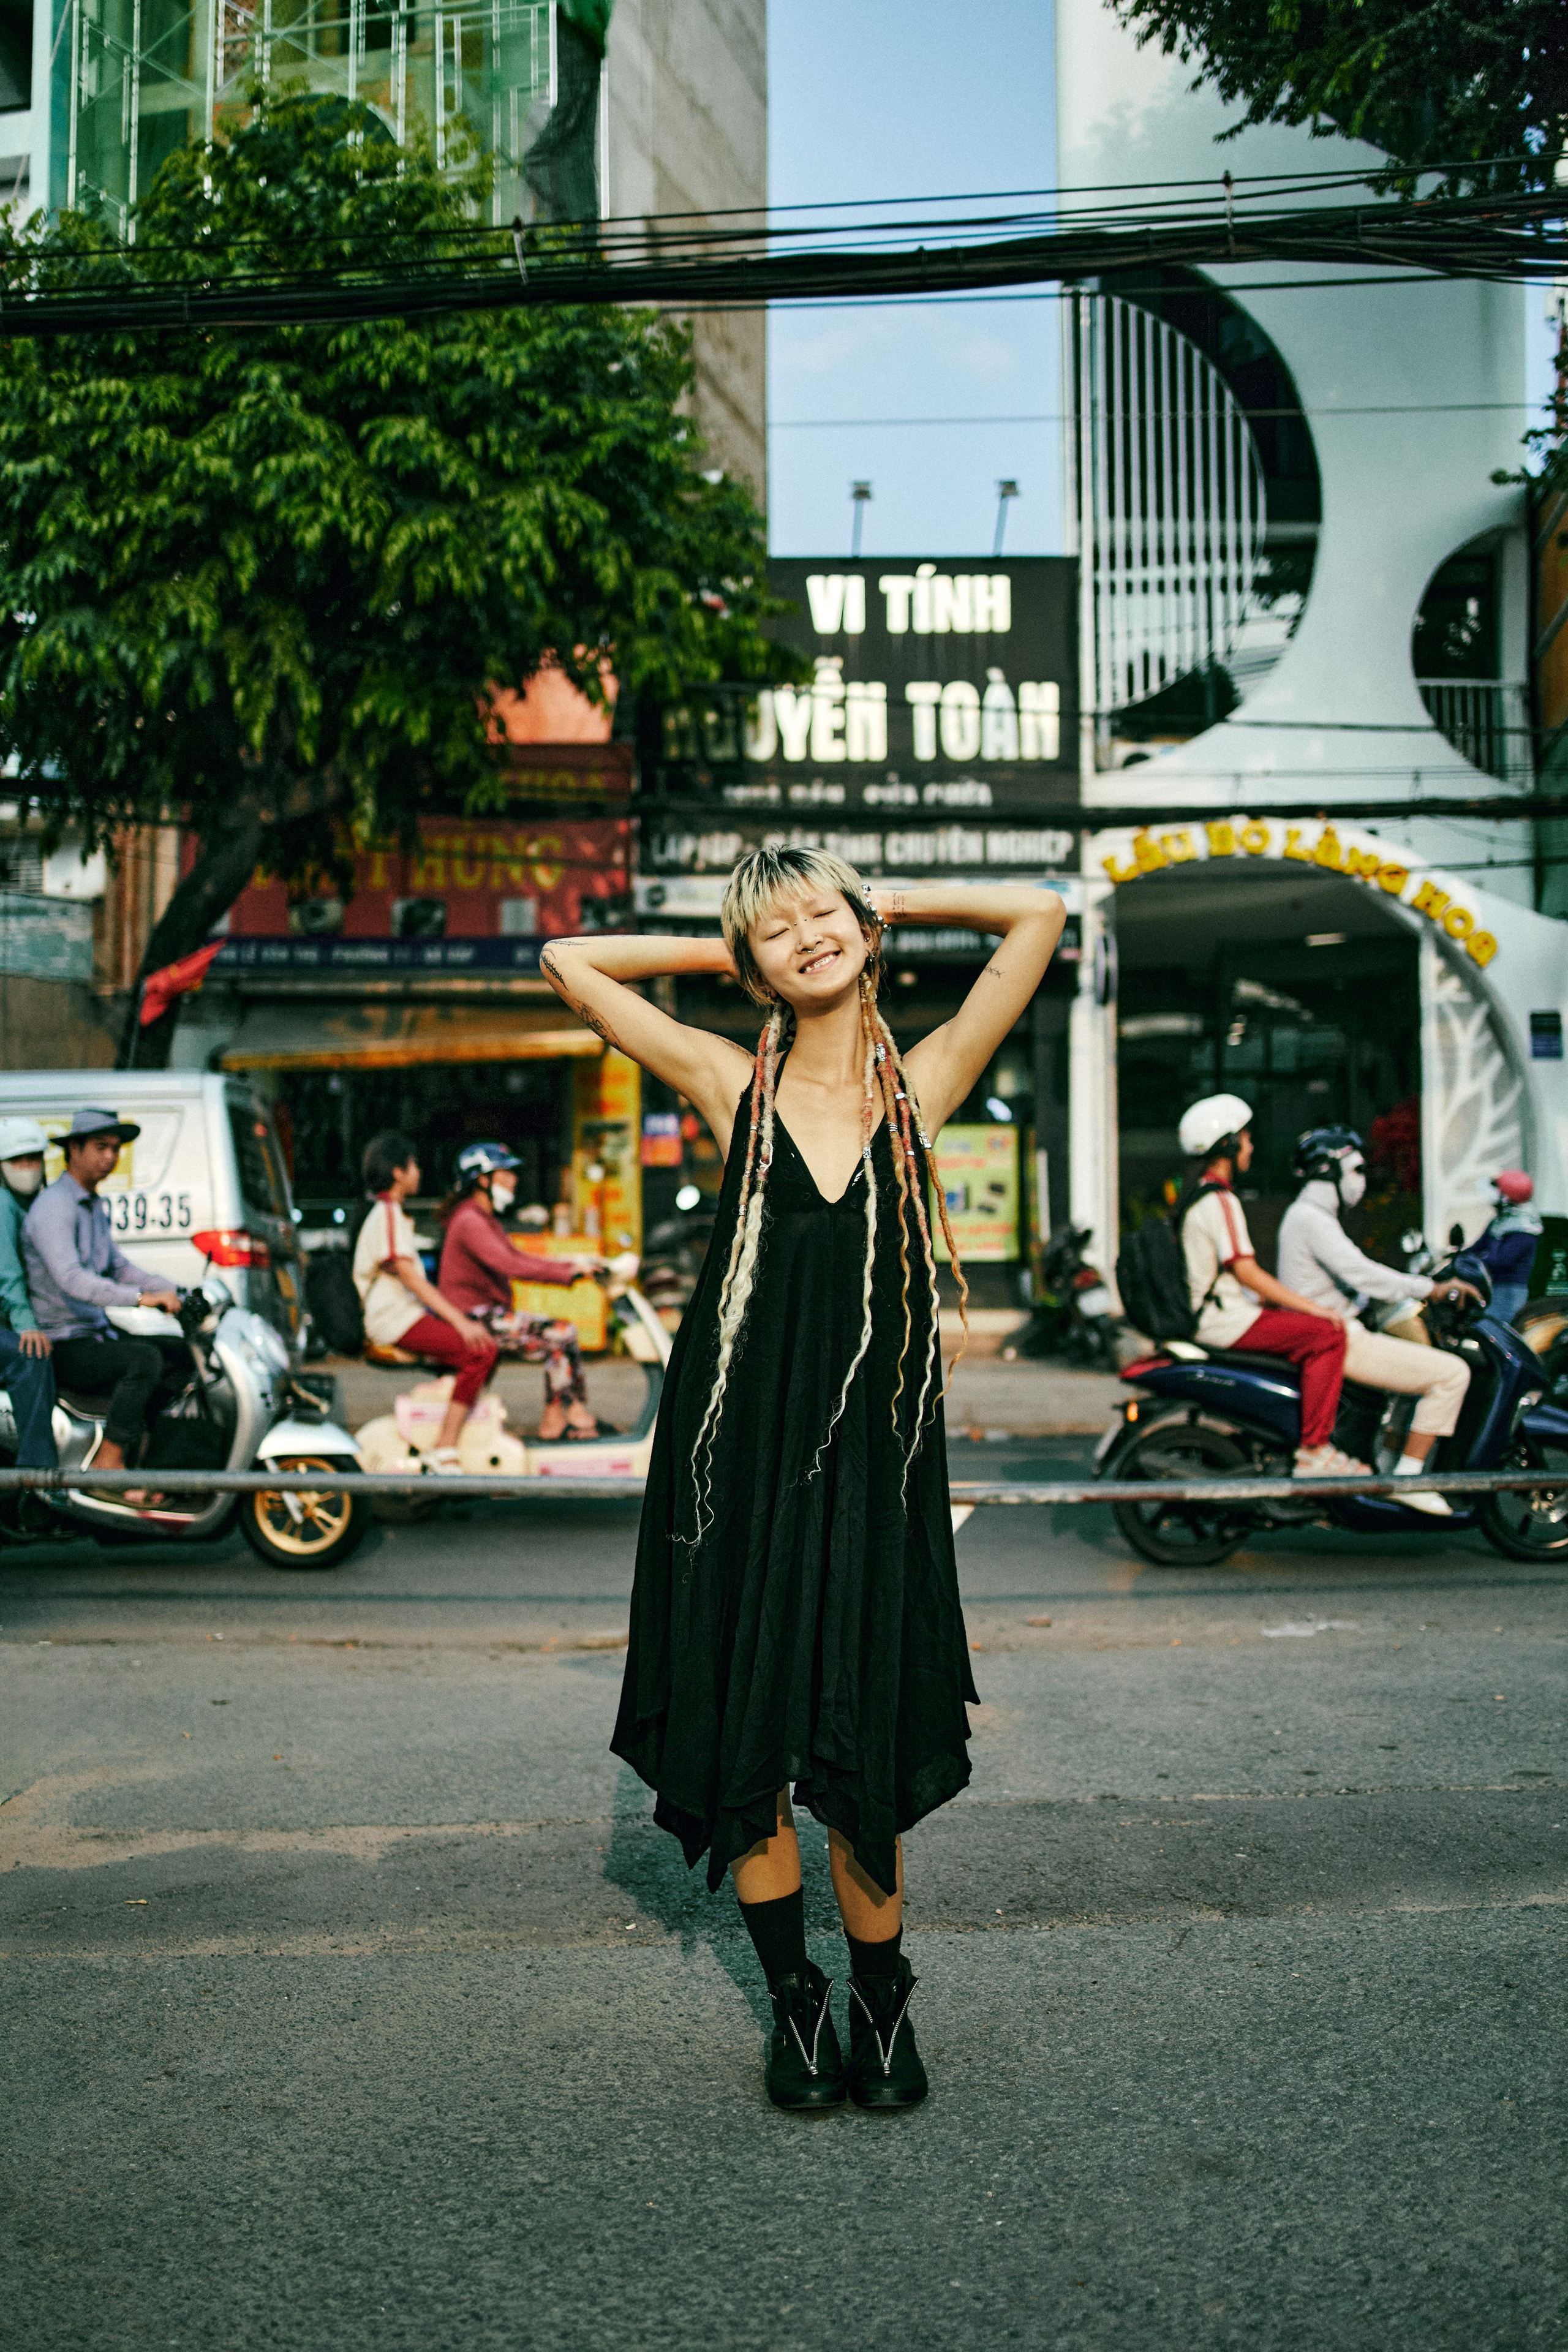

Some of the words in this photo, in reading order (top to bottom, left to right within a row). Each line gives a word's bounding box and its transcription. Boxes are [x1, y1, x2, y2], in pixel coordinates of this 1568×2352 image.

[805, 575, 866, 634] VI
[878, 564, 1012, 634] TÍNH
[905, 668, 1060, 761] TOÀN
